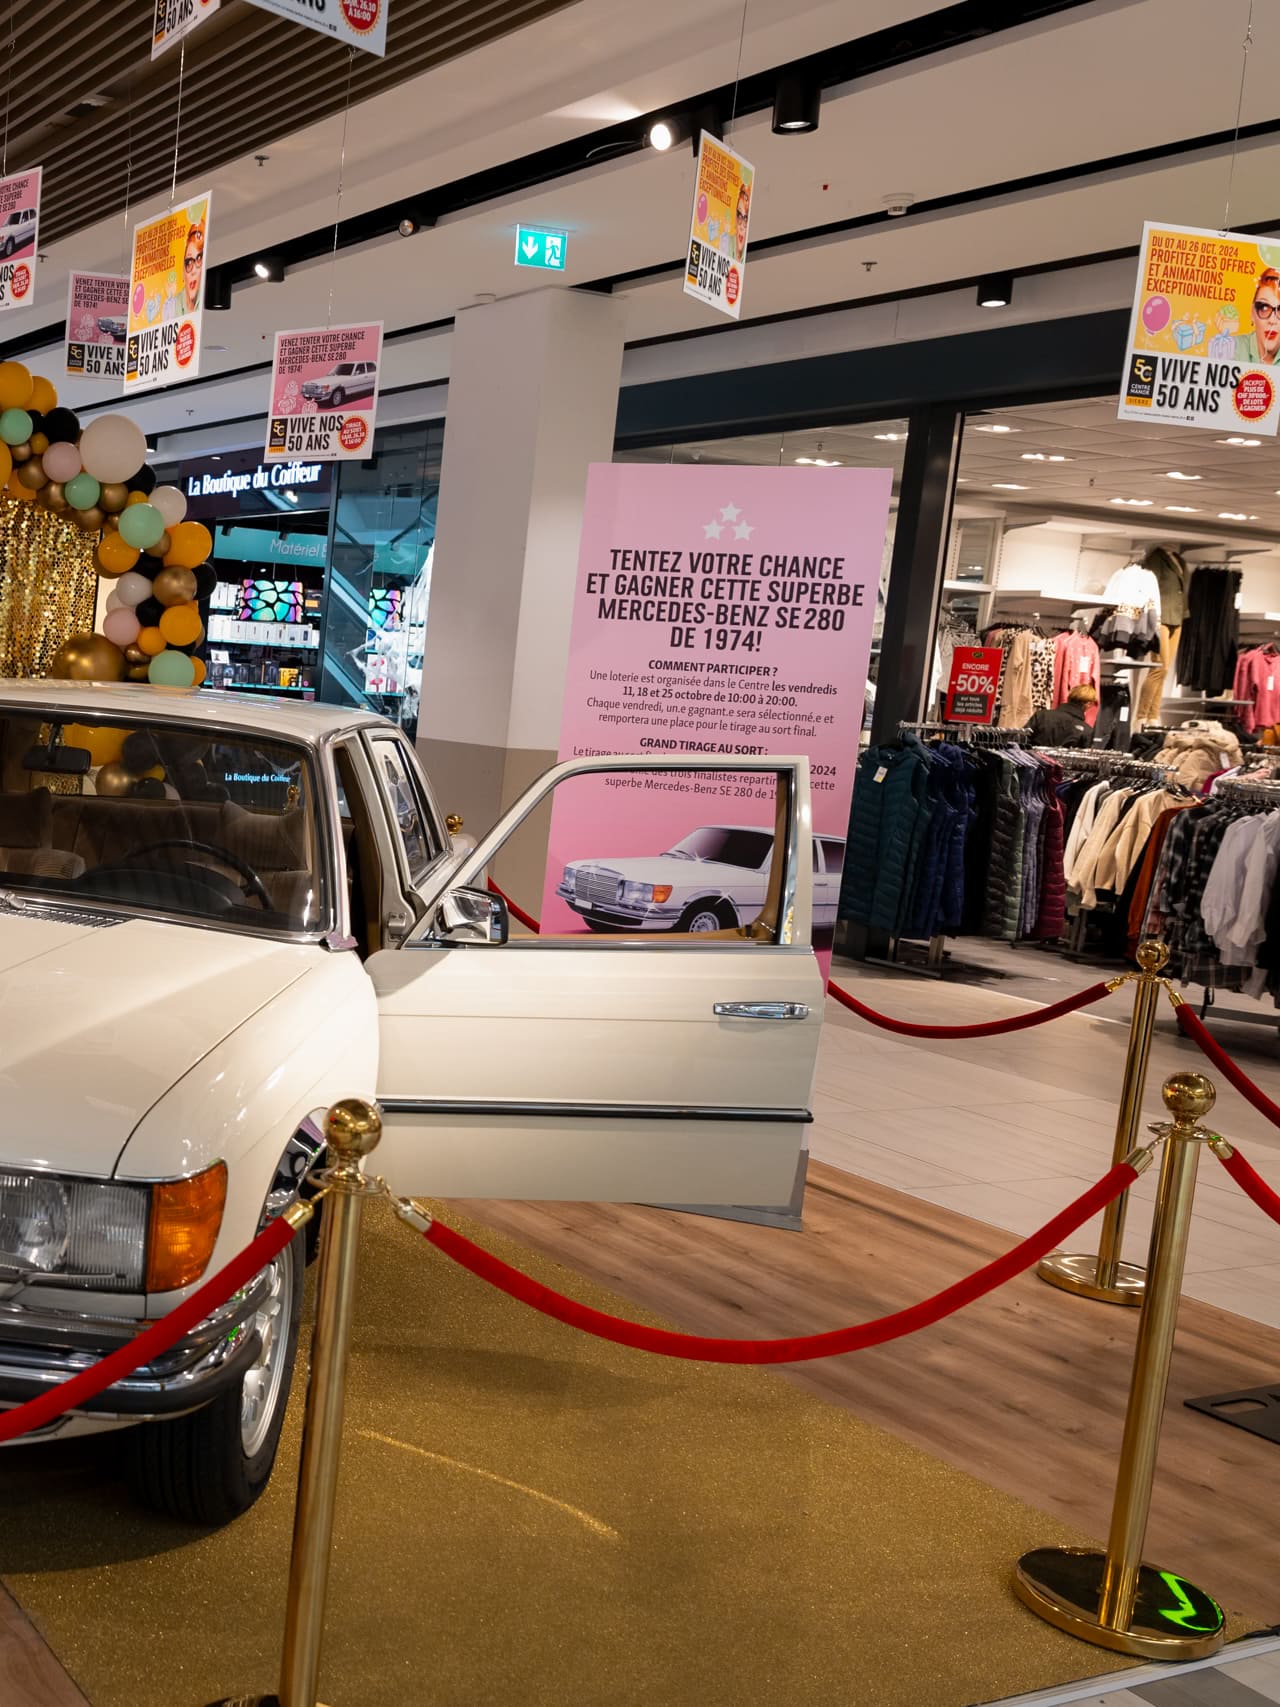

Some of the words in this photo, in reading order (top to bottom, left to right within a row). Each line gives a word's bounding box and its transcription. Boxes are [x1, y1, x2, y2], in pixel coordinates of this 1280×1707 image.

[355, 10, 371, 22] 16:00
[1152, 236, 1163, 246] DU
[1165, 237, 1174, 248] 07
[1176, 238, 1187, 250] AU
[1189, 240, 1199, 251] 26
[1201, 242, 1217, 254] OCT.
[1220, 244, 1239, 257] 2024
[1151, 248, 1196, 266] PROFITEZ
[1200, 254, 1218, 269] DES
[1220, 258, 1256, 275] OFFRES
[1148, 263, 1160, 276] ET
[1162, 264, 1224, 286] ANIMATIONS
[1146, 278, 1236, 302] EXCEPTIONNELLES
[140, 330, 159, 353] VIVE
[161, 322, 179, 346] NOS
[280, 338, 298, 348] VENEZ
[300, 336, 321, 345] TENTER
[322, 333, 340, 343] VOTRE
[342, 331, 365, 342] CHANCE
[280, 348, 287, 356] ET
[288, 346, 310, 356] GAGNER
[311, 344, 328, 353] CETTE
[330, 341, 356, 352] SUPERBE
[139, 354, 151, 376] 50
[152, 348, 169, 372] ANS
[279, 354, 326, 366] MERCEDES-BENZ
[279, 366, 286, 375] DE
[288, 364, 303, 374] 1974!
[1161, 357, 1201, 384] VIVE
[1205, 363, 1241, 389] NOS
[1156, 384, 1179, 409] 50
[1184, 387, 1220, 413] ANS
[290, 416, 316, 434] VIVE
[319, 415, 344, 432] NOS
[288, 435, 302, 452] 50
[306, 434, 330, 451] ANS
[188, 477, 200, 496] La
[202, 470, 250, 498] Boutique
[253, 466, 268, 488] du
[271, 461, 322, 486] Coiffeur
[270, 538, 320, 557] Matériel
[610, 549, 683, 573] TENTEZ
[689, 552, 753, 576] VOTRE
[759, 554, 845, 580] CHANCE
[586, 573, 610, 594] ET
[614, 574, 694, 599] GAGNER
[700, 578, 762, 602] CETTE
[767, 580, 865, 607] SUPERBE
[598, 598, 770, 628] MERCEDES-BENZ
[670, 626, 696, 649] DE
[704, 627, 762, 652] 1974!
[648, 660, 706, 674] COMMENT
[707, 662, 771, 676] PARTICIPER
[590, 670, 608, 682] Une
[610, 671, 639, 683] loterie
[641, 674, 655, 685] est
[657, 674, 701, 688] organisée
[703, 676, 726, 688] dans
[728, 677, 736, 689] le
[738, 679, 770, 691] Centre
[772, 680, 786, 692] les
[788, 681, 837, 695] vendredis
[952, 674, 995, 693] -50%
[622, 686, 635, 698] 11,
[637, 686, 648, 697] 18
[650, 688, 660, 698] et
[661, 688, 673, 699] 25
[674, 689, 712, 701] octobre
[714, 690, 726, 701] de
[728, 691, 756, 703] 10:00
[758, 692, 764, 704] à
[766, 694, 798, 707] 20:00.
[586, 697, 620, 712] Chaque
[622, 700, 664, 713] vendredi,
[666, 704, 686, 714] un.e
[688, 704, 735, 719] gagnant.e
[736, 708, 756, 719] sera
[758, 708, 822, 723] sélectionné.e
[824, 714, 834, 724] et
[599, 712, 649, 727] remportera
[651, 717, 668, 728] une
[669, 717, 694, 732] place
[695, 720, 718, 733] pour
[720, 720, 728, 731] le
[730, 721, 756, 735] tirage
[758, 724, 770, 734] au
[772, 724, 792, 735] sort
[793, 724, 817, 737] final.
[640, 738, 678, 751] GRAND
[679, 740, 718, 752] TIRAGE
[718, 743, 733, 753] AU
[734, 744, 763, 756] SORT
[225, 772, 232, 781] La
[233, 773, 260, 783] Boutique
[261, 774, 269, 782] du
[693, 770, 737, 782] finalistes
[810, 764, 836, 777] 2024
[605, 776, 642, 789] superbe
[644, 778, 718, 796] Mercedes-Benz
[720, 785, 732, 797] SE
[734, 786, 753, 798] 280
[755, 788, 768, 799] de
[810, 780, 835, 791] cette
